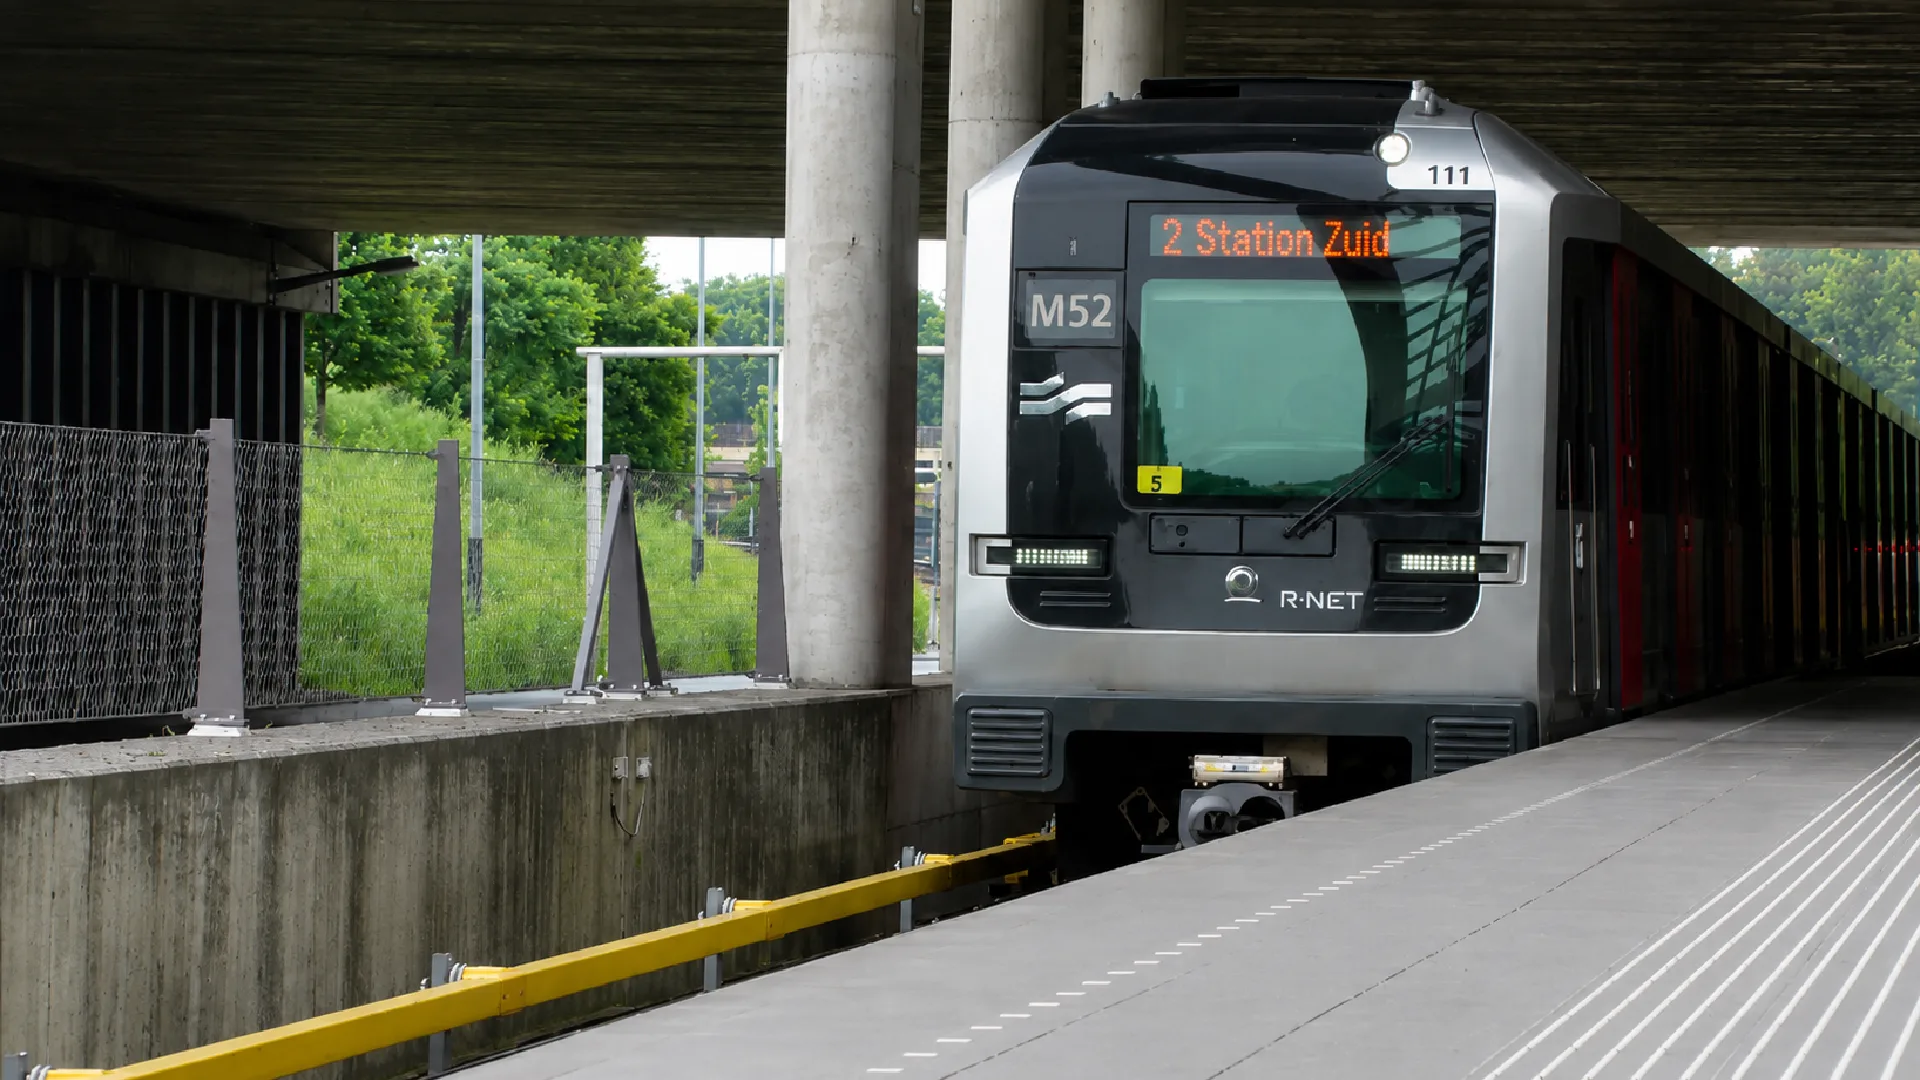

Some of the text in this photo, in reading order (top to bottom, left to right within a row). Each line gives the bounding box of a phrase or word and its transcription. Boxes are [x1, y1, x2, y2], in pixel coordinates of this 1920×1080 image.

[1428, 165, 1469, 185] 111
[1163, 218, 1390, 257] 2 Station Zuid
[1031, 294, 1112, 328] M52
[1151, 475, 1162, 493] 5
